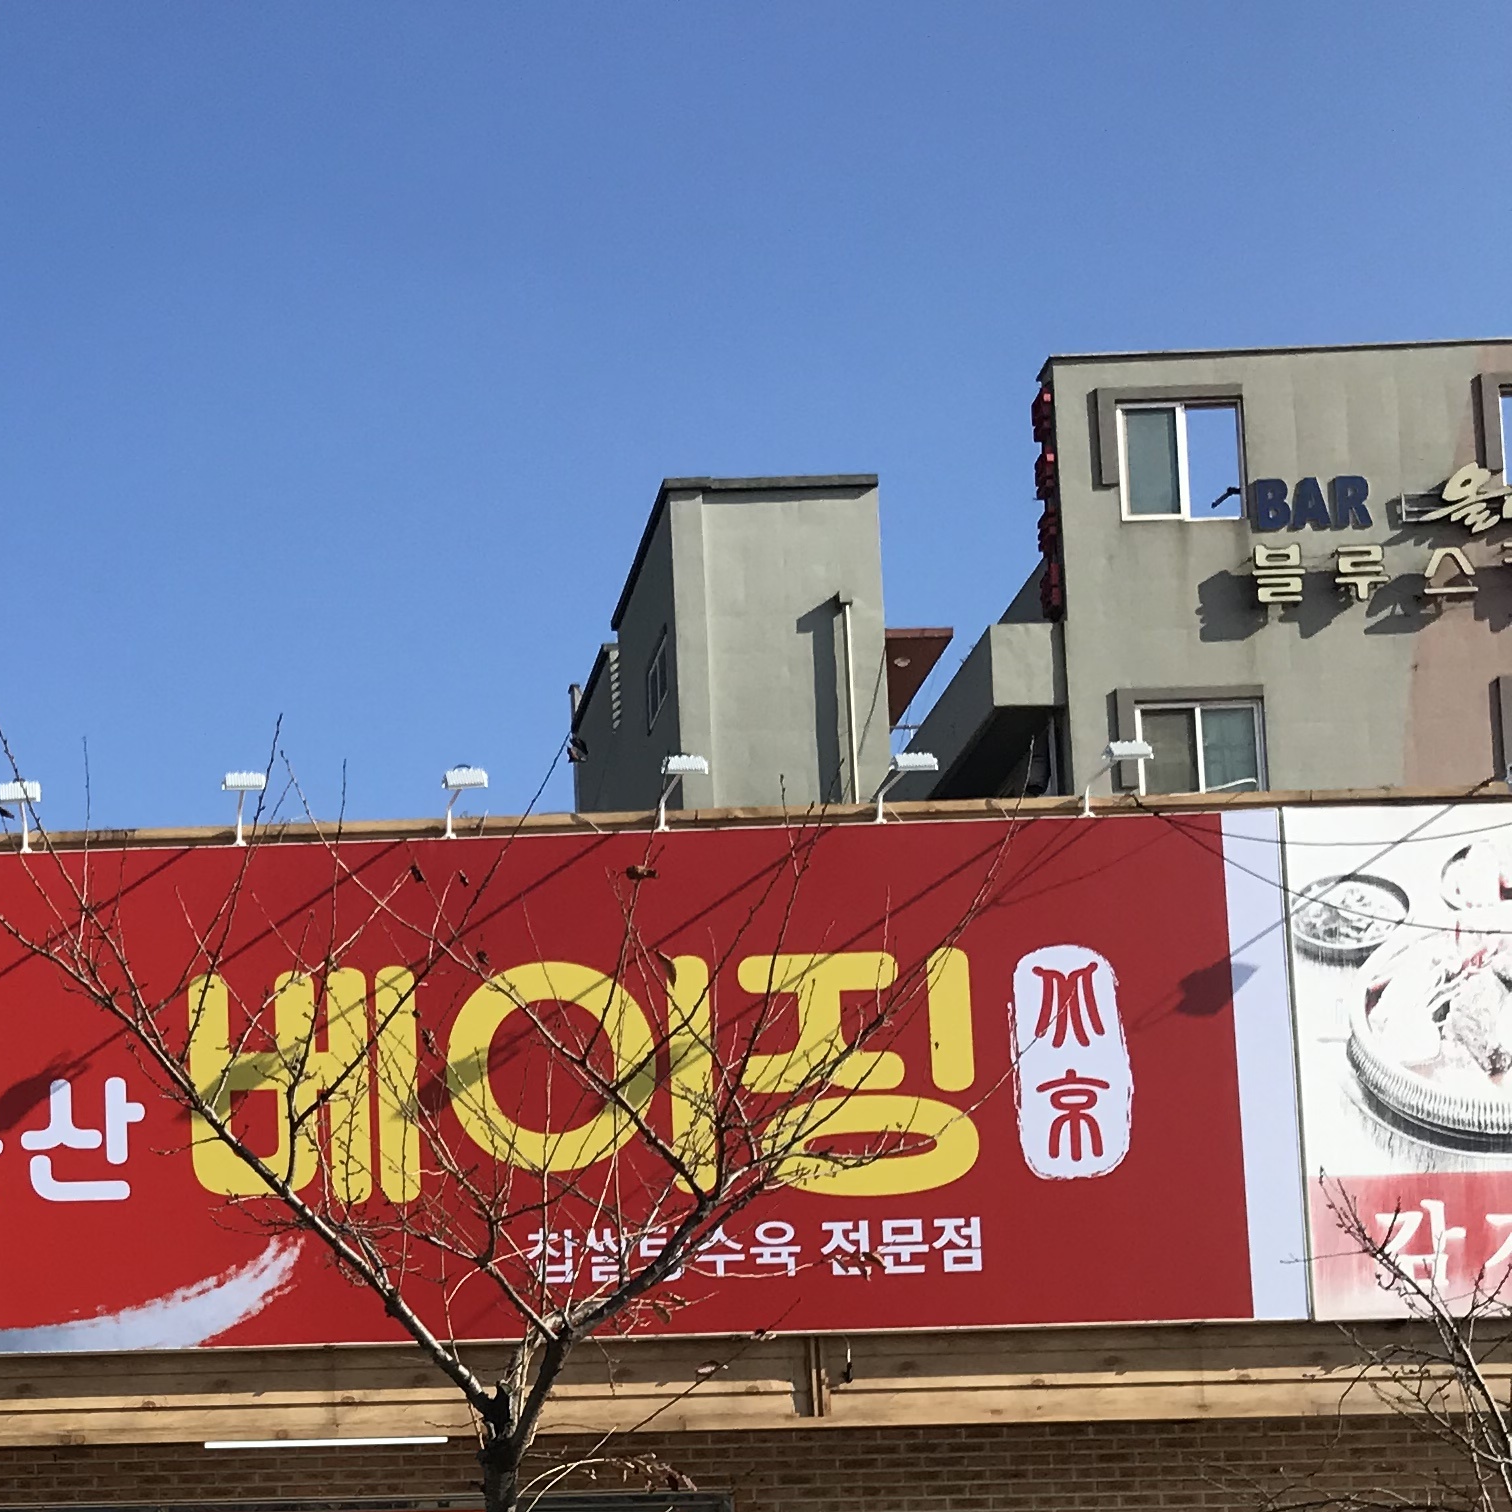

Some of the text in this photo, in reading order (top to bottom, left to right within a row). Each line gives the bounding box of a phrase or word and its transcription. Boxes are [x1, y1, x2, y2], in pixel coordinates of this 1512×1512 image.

[1253, 476, 1373, 531] BAR
[1418, 462, 1512, 534] 올
[1251, 543, 1512, 603] 블루스
[187, 946, 981, 1207] 베이징
[820, 1216, 984, 1277] 전문점
